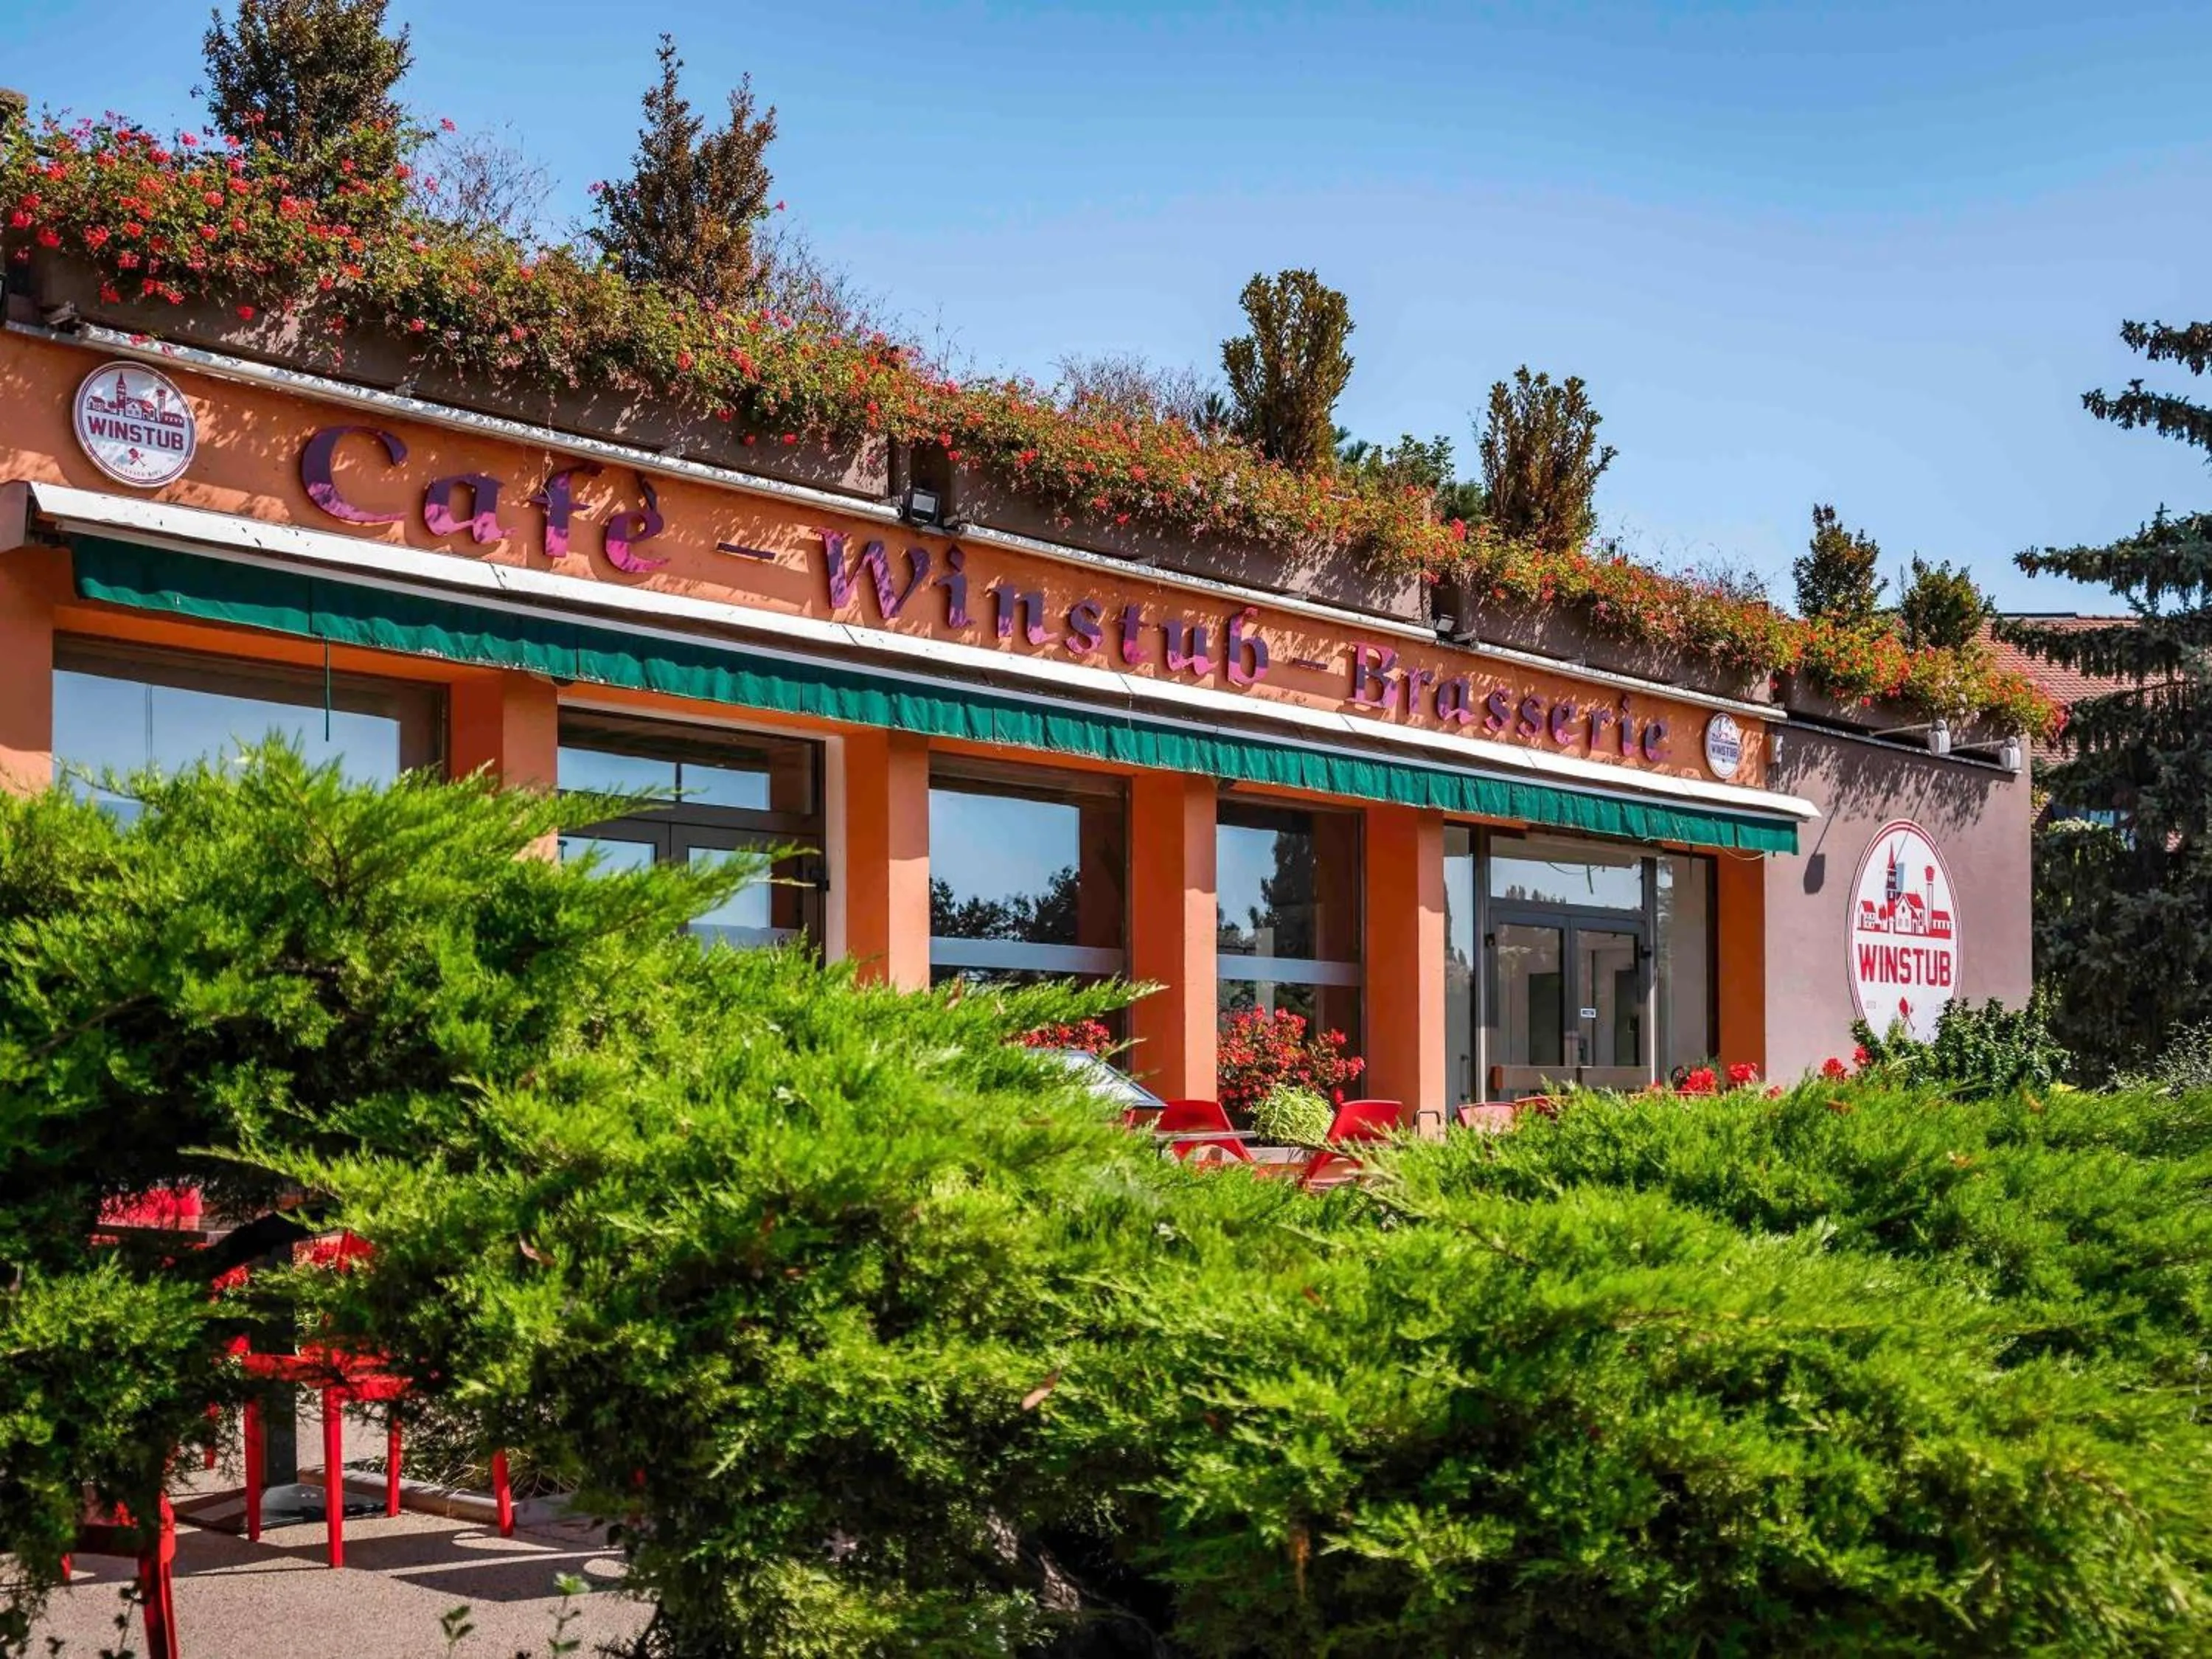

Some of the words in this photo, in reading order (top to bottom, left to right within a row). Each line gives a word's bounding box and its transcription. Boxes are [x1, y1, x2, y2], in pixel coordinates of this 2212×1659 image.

[87, 416, 184, 451] WINSTUB
[813, 527, 1268, 685] Winstub
[1346, 641, 1671, 762] Brasserie
[1857, 944, 1951, 987] WINSTUB
